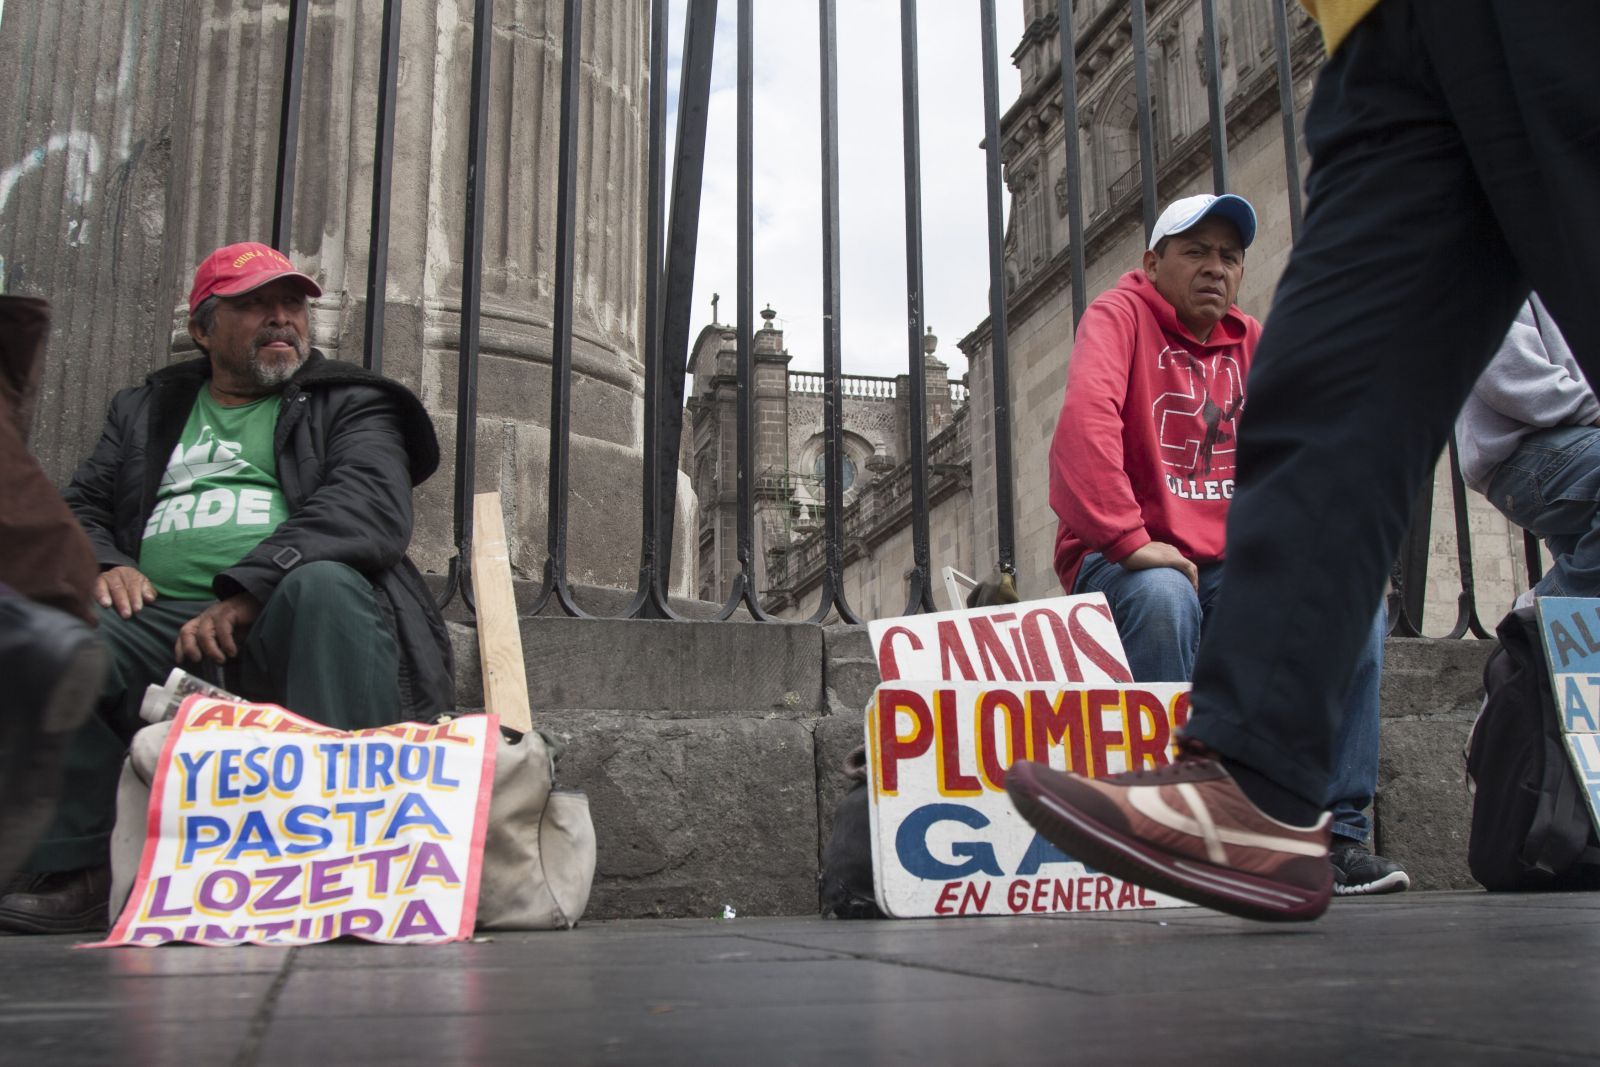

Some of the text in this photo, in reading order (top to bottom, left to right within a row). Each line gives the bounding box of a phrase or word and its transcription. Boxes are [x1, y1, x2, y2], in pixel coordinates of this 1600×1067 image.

[1550, 607, 1600, 667] AL
[175, 743, 460, 806] YESO TIROL
[177, 792, 452, 867] PASTA
[142, 843, 461, 920] LOZETA
[934, 876, 1157, 915] EN GENERAL
